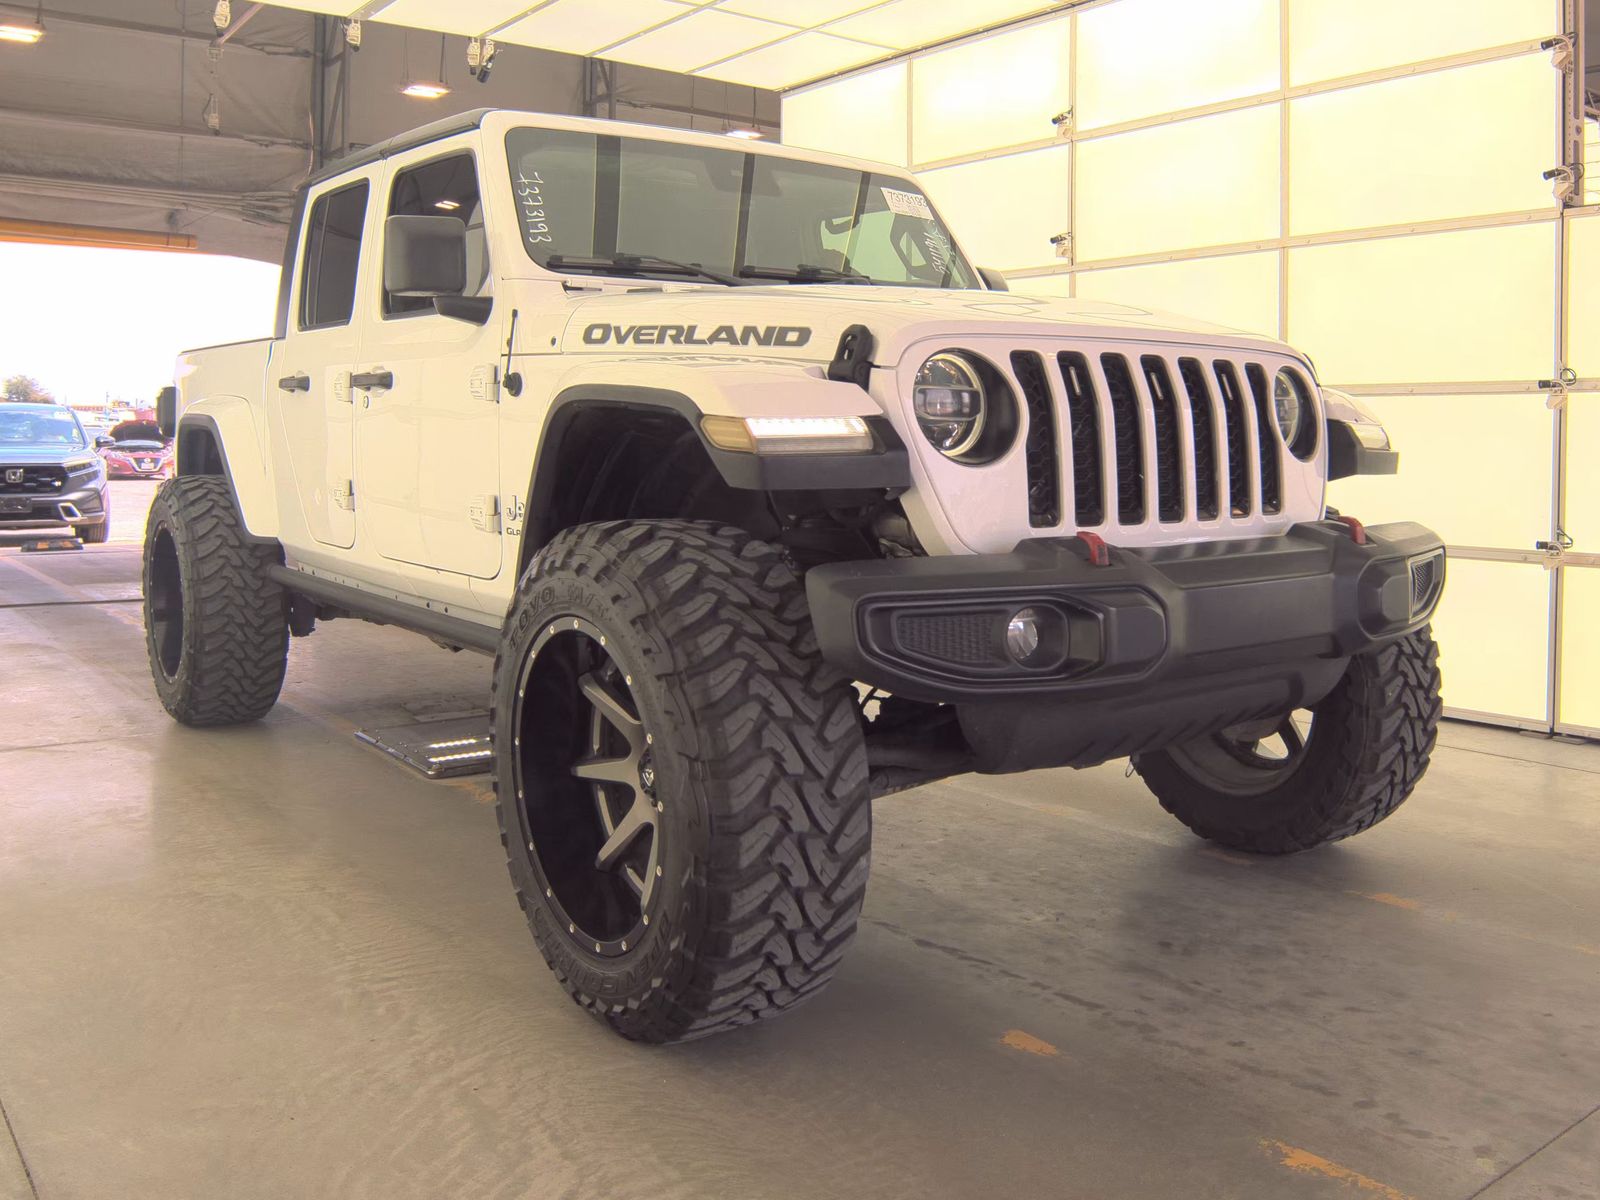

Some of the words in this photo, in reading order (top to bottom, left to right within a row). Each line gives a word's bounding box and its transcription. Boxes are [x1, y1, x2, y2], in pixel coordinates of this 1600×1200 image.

[516, 171, 552, 243] 7373193
[582, 323, 812, 347] OVERLAND
[508, 585, 556, 650] TOYO
